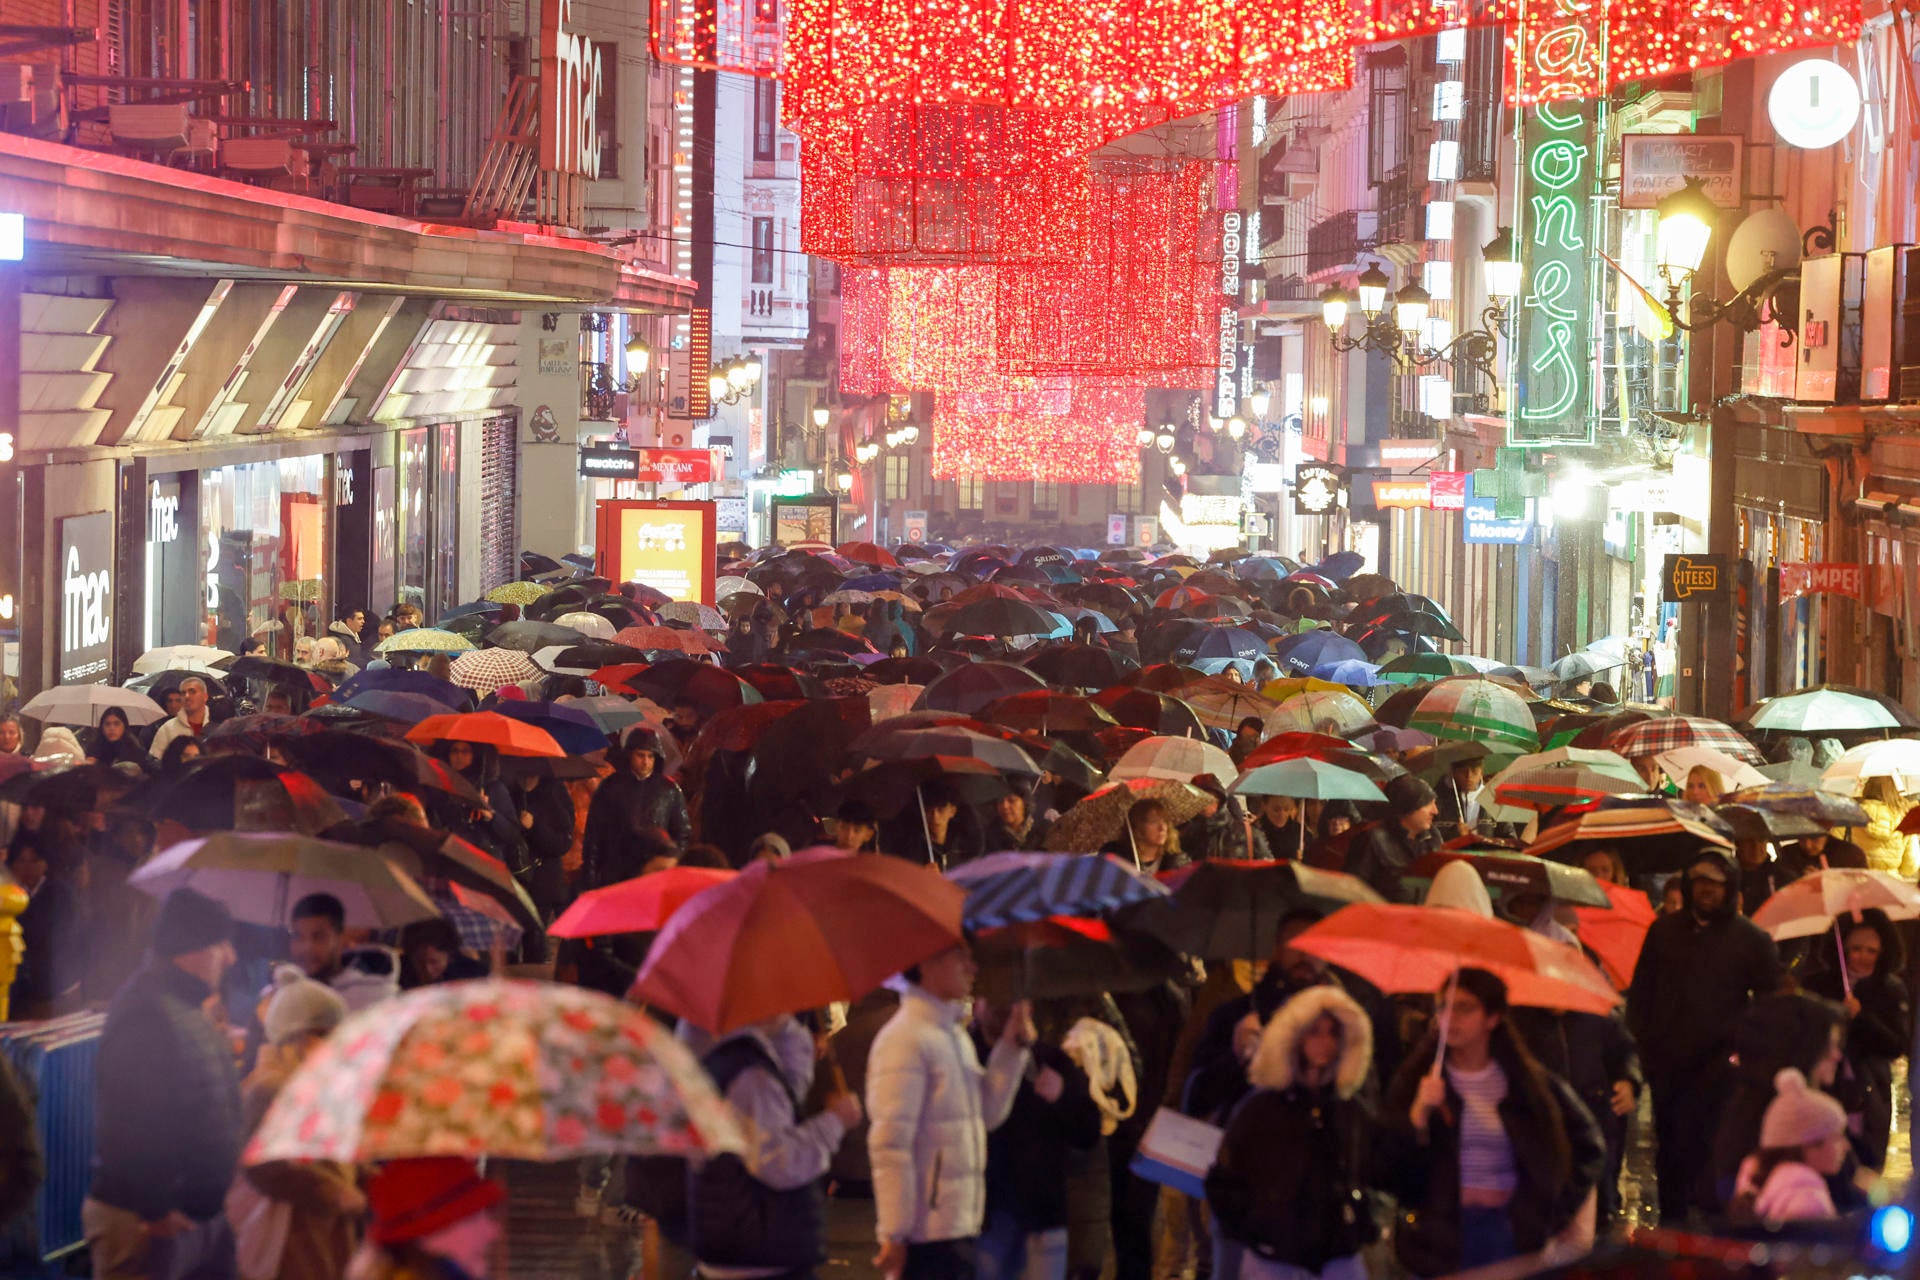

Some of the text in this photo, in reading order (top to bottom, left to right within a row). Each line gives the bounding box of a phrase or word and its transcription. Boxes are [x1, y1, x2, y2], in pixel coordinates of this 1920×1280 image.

[555, 0, 603, 183] fnac
[1222, 212, 1241, 295] 2000
[151, 479, 179, 543] fnac
[335, 455, 354, 505] fnac
[1469, 522, 1528, 542] Money
[64, 545, 110, 652] fnac
[1673, 570, 1712, 585] CITEES
